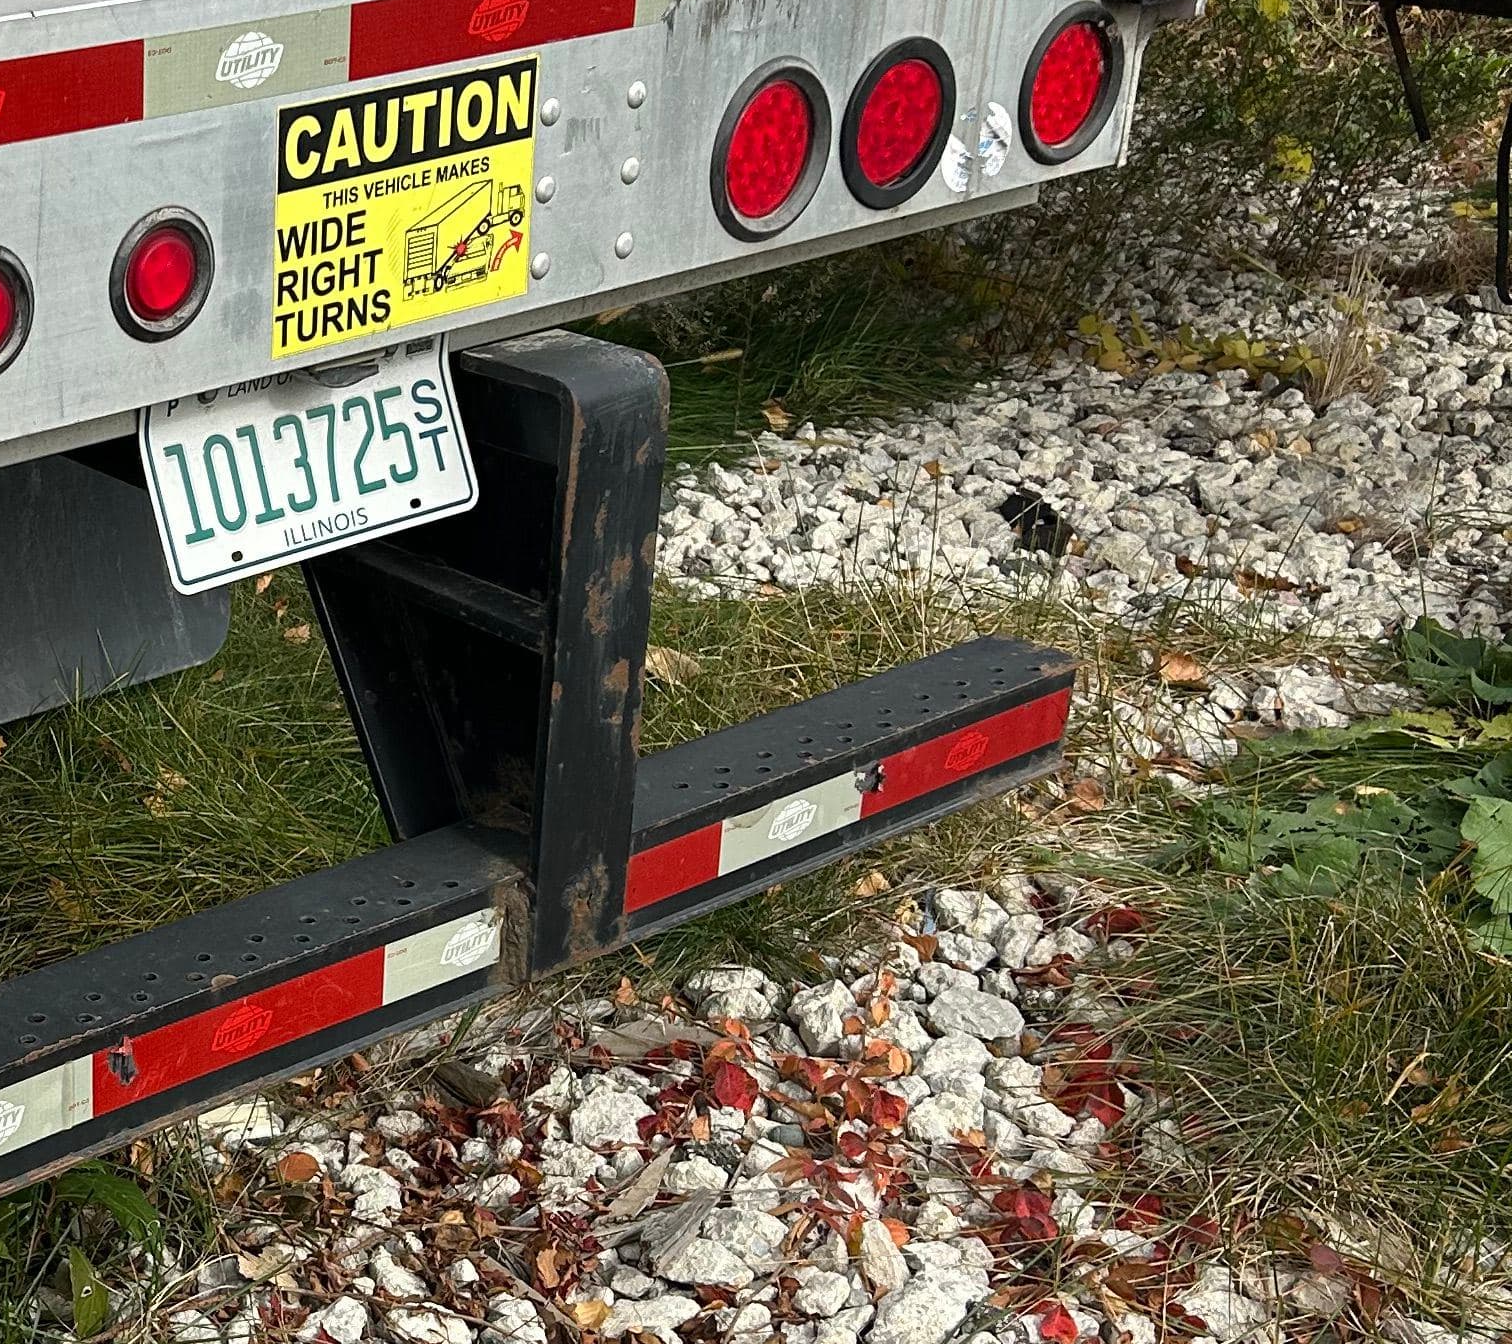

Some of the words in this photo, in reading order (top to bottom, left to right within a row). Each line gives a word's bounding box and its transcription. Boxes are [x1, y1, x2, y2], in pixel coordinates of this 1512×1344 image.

[473, 3, 526, 32] UTILITY
[220, 47, 280, 77] UTILITY
[285, 70, 532, 180] CAUTION
[323, 186, 359, 209] THIS
[363, 169, 431, 200] VEHICLE
[436, 157, 490, 183] MAKES
[277, 210, 366, 263] WIDE
[277, 248, 383, 307] RIGHT
[275, 289, 392, 347] TURNS
[163, 386, 418, 545] 1013725
[283, 507, 369, 547] ILLINOIS
[444, 928, 494, 961] UTILITY
[215, 1012, 271, 1048] UTILITY
